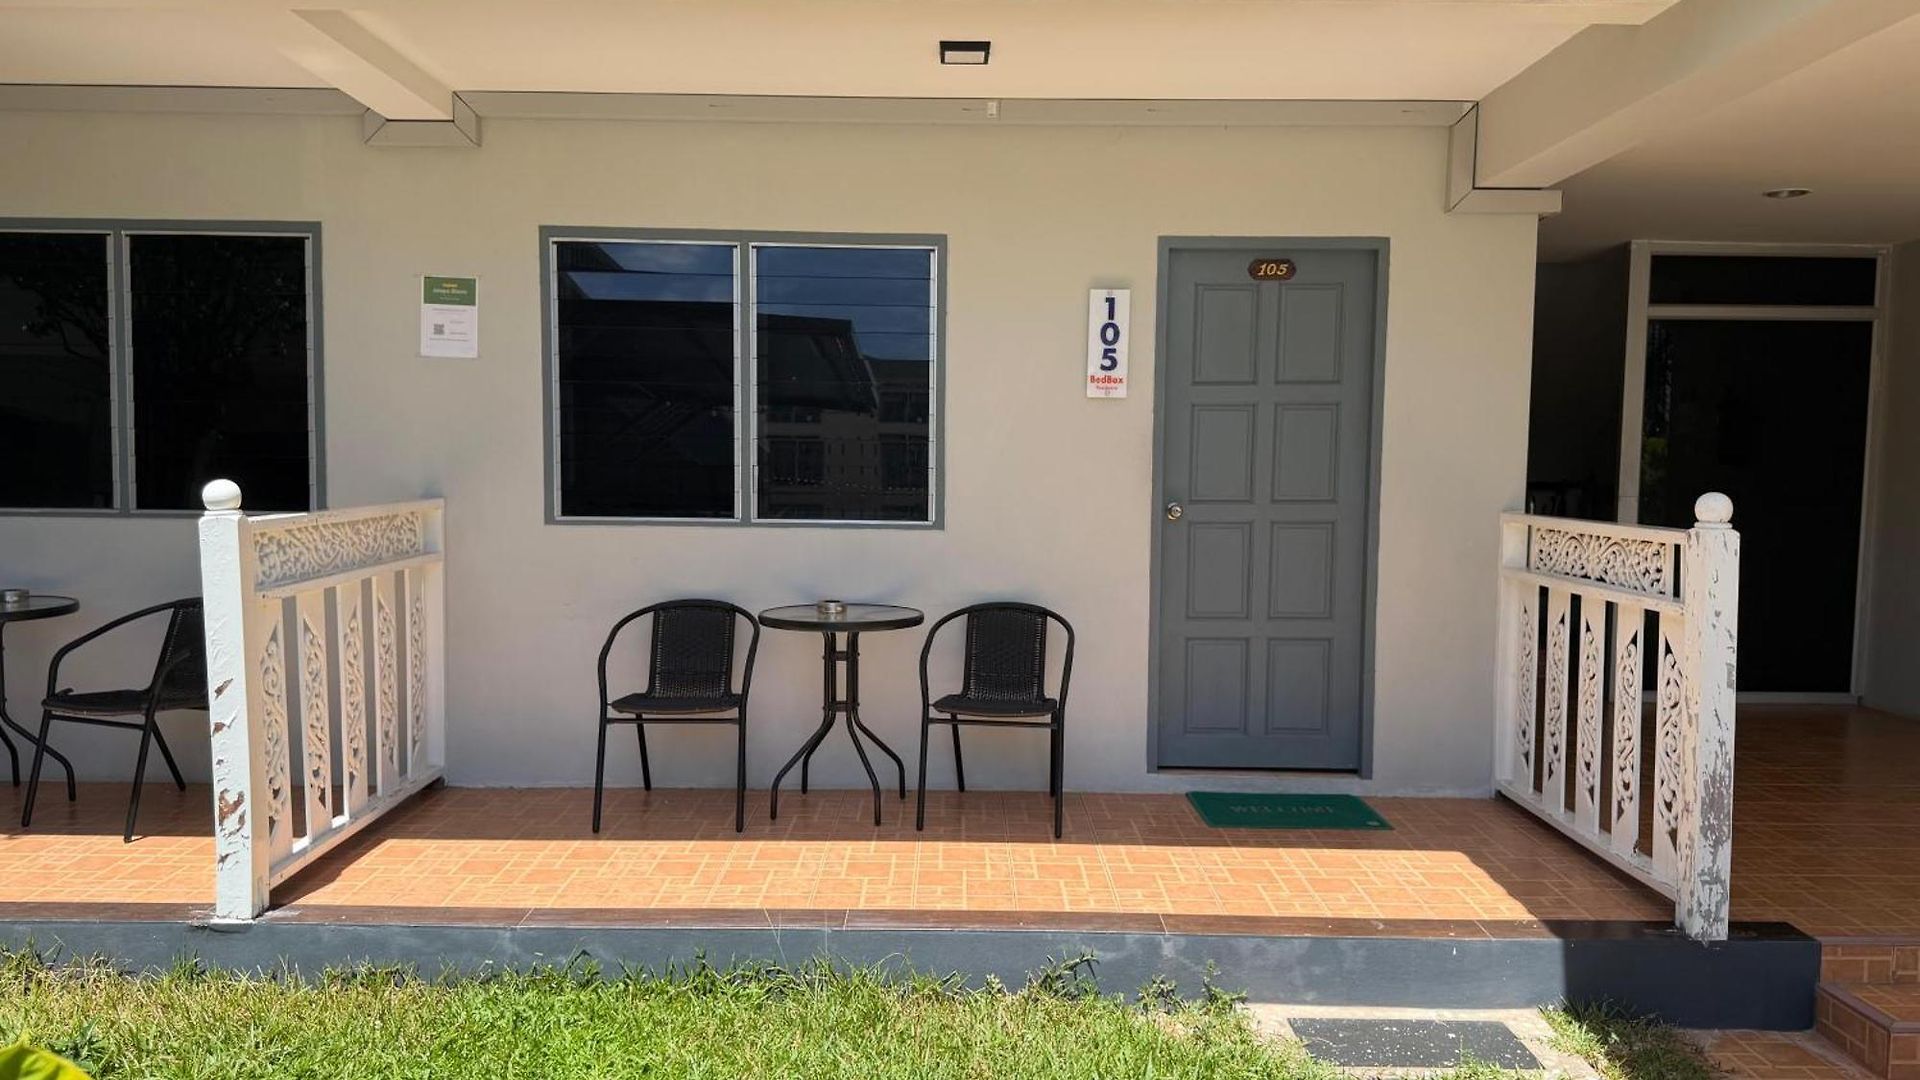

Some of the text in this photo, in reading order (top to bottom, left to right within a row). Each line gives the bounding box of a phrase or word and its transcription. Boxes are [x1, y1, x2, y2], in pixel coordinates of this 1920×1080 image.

[1257, 263, 1289, 276] 105
[1100, 297, 1120, 371] 105
[1090, 375, 1124, 384] BedBox
